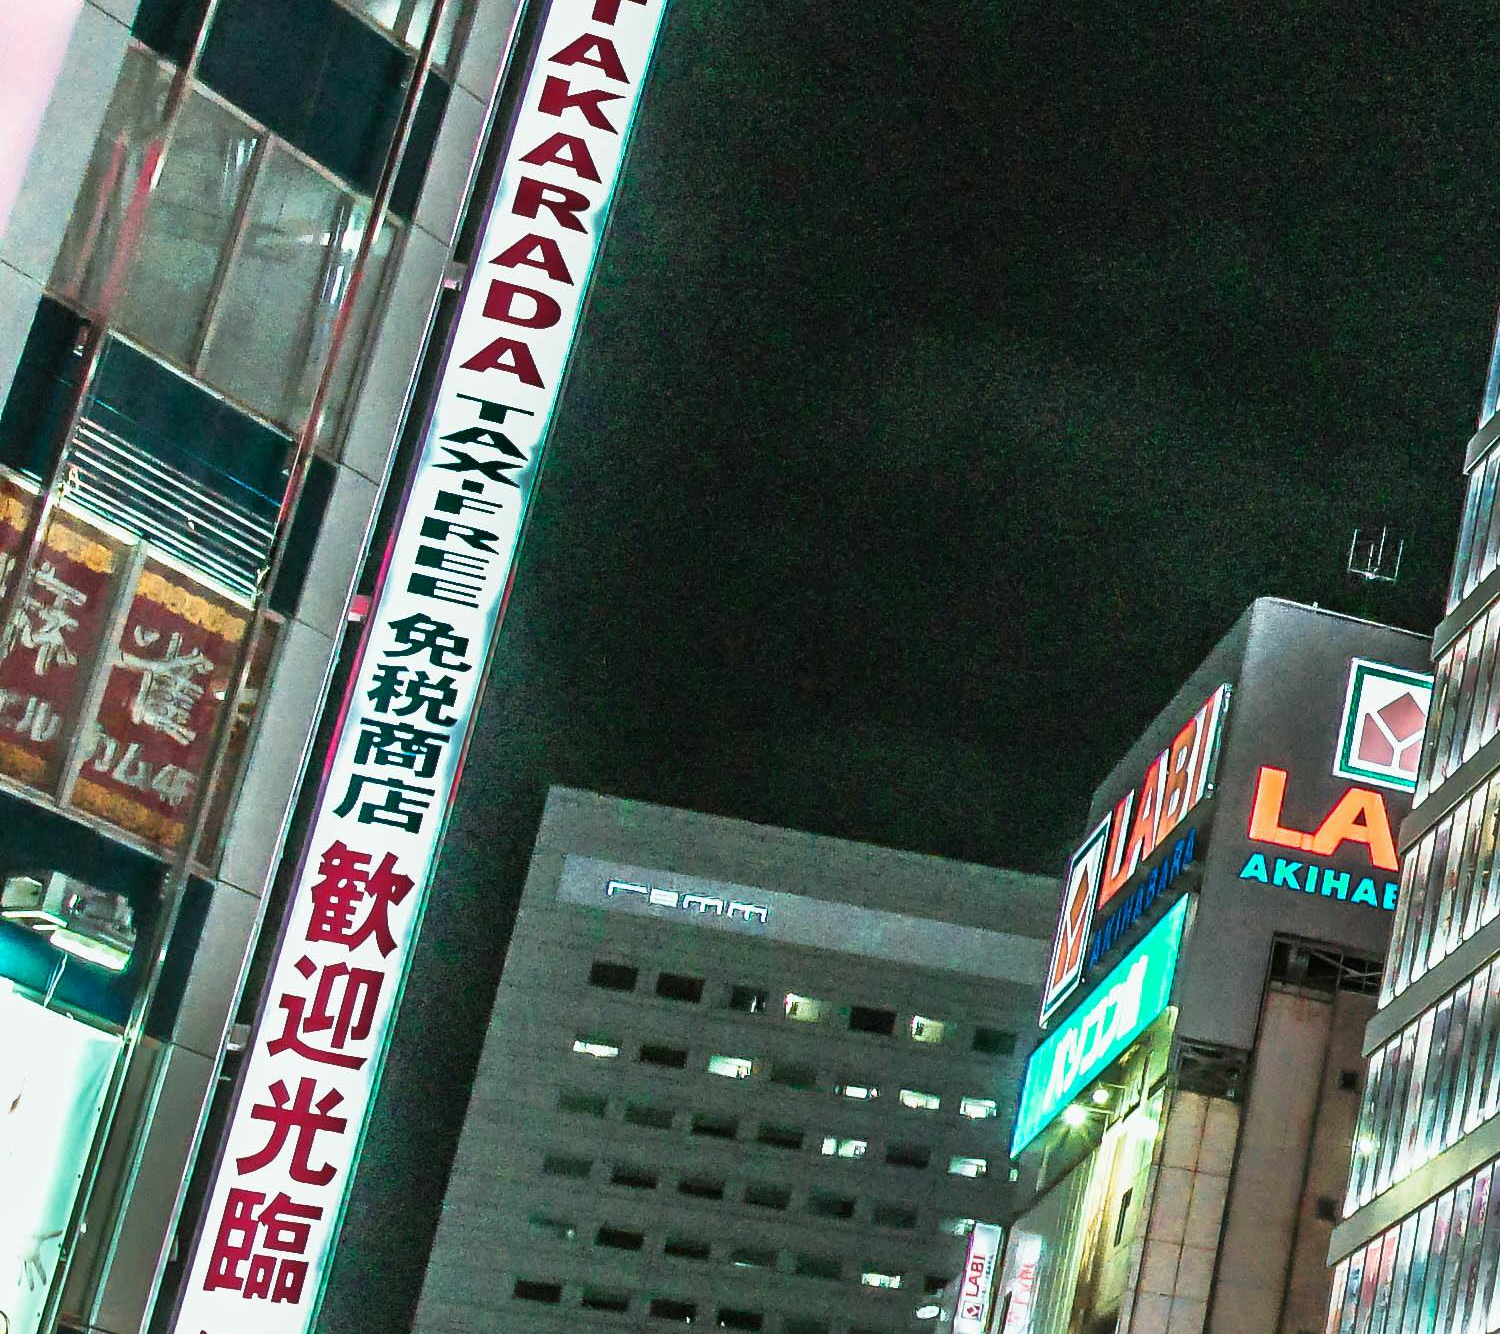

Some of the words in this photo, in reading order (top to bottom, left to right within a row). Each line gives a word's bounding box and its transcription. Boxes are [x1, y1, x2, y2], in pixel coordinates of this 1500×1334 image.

[333, 612, 474, 835] 免税商店
[1099, 703, 1217, 911] LABI
[607, 877, 769, 924] remm
[1089, 827, 1198, 971] AKIHABARA
[202, 839, 416, 1305] 歓迎光臨
[963, 1252, 986, 1304] LABI
